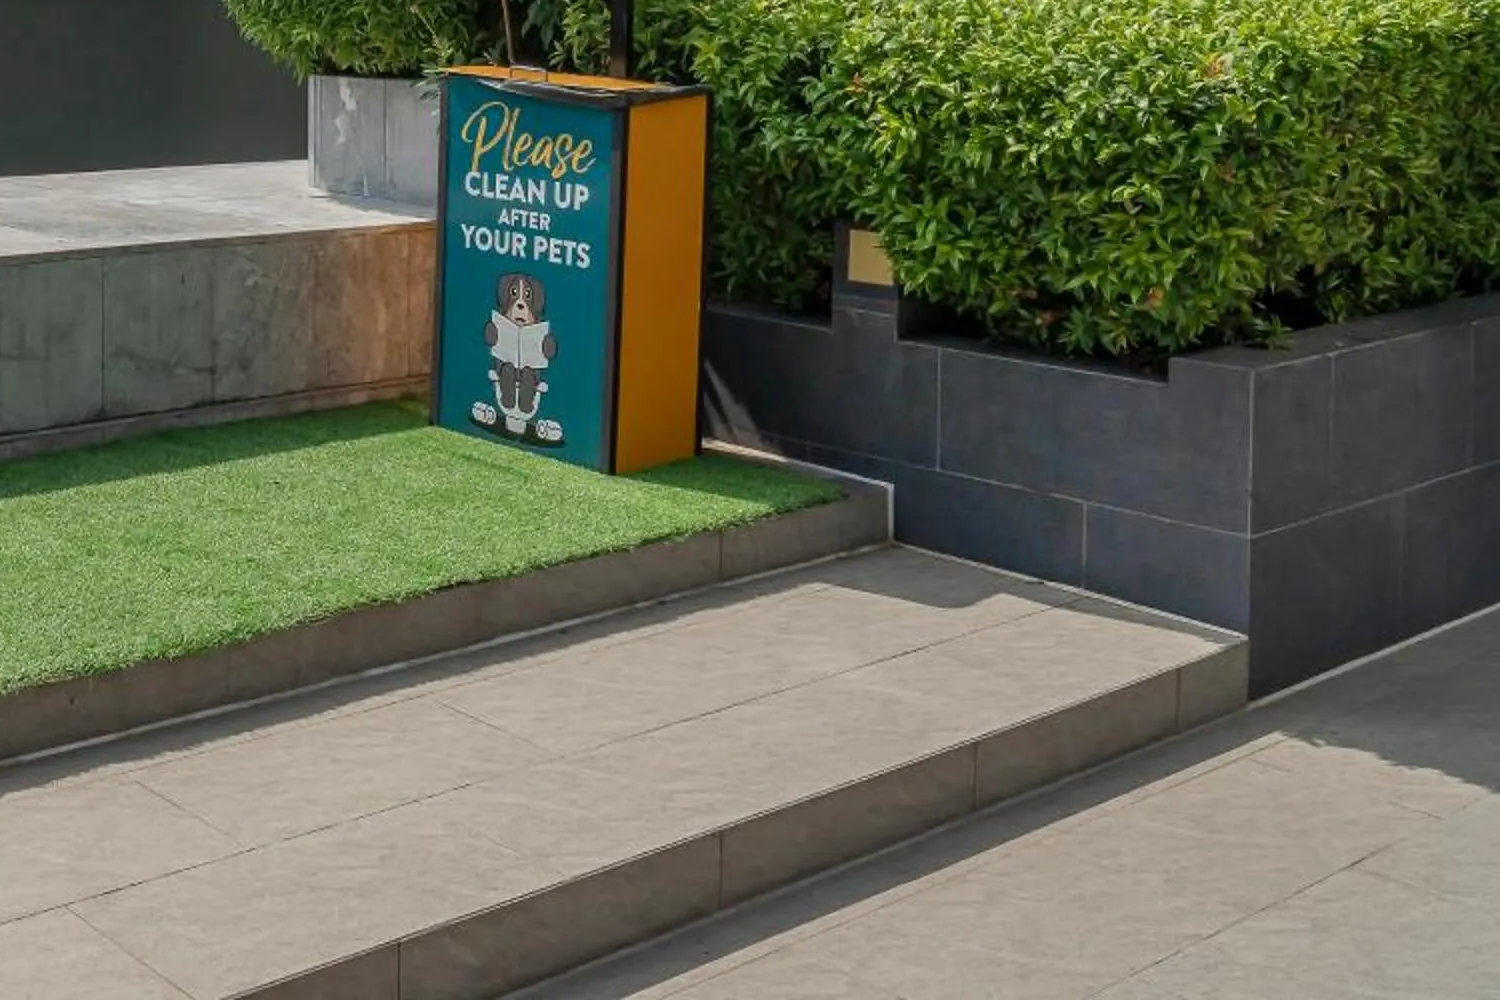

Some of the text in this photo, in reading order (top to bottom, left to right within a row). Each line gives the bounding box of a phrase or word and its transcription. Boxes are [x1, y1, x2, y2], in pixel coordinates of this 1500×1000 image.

[460, 101, 596, 179] Please
[464, 171, 590, 211] CLEAN UP
[498, 208, 551, 232] AFTER
[461, 224, 592, 269] YOUR PETS
